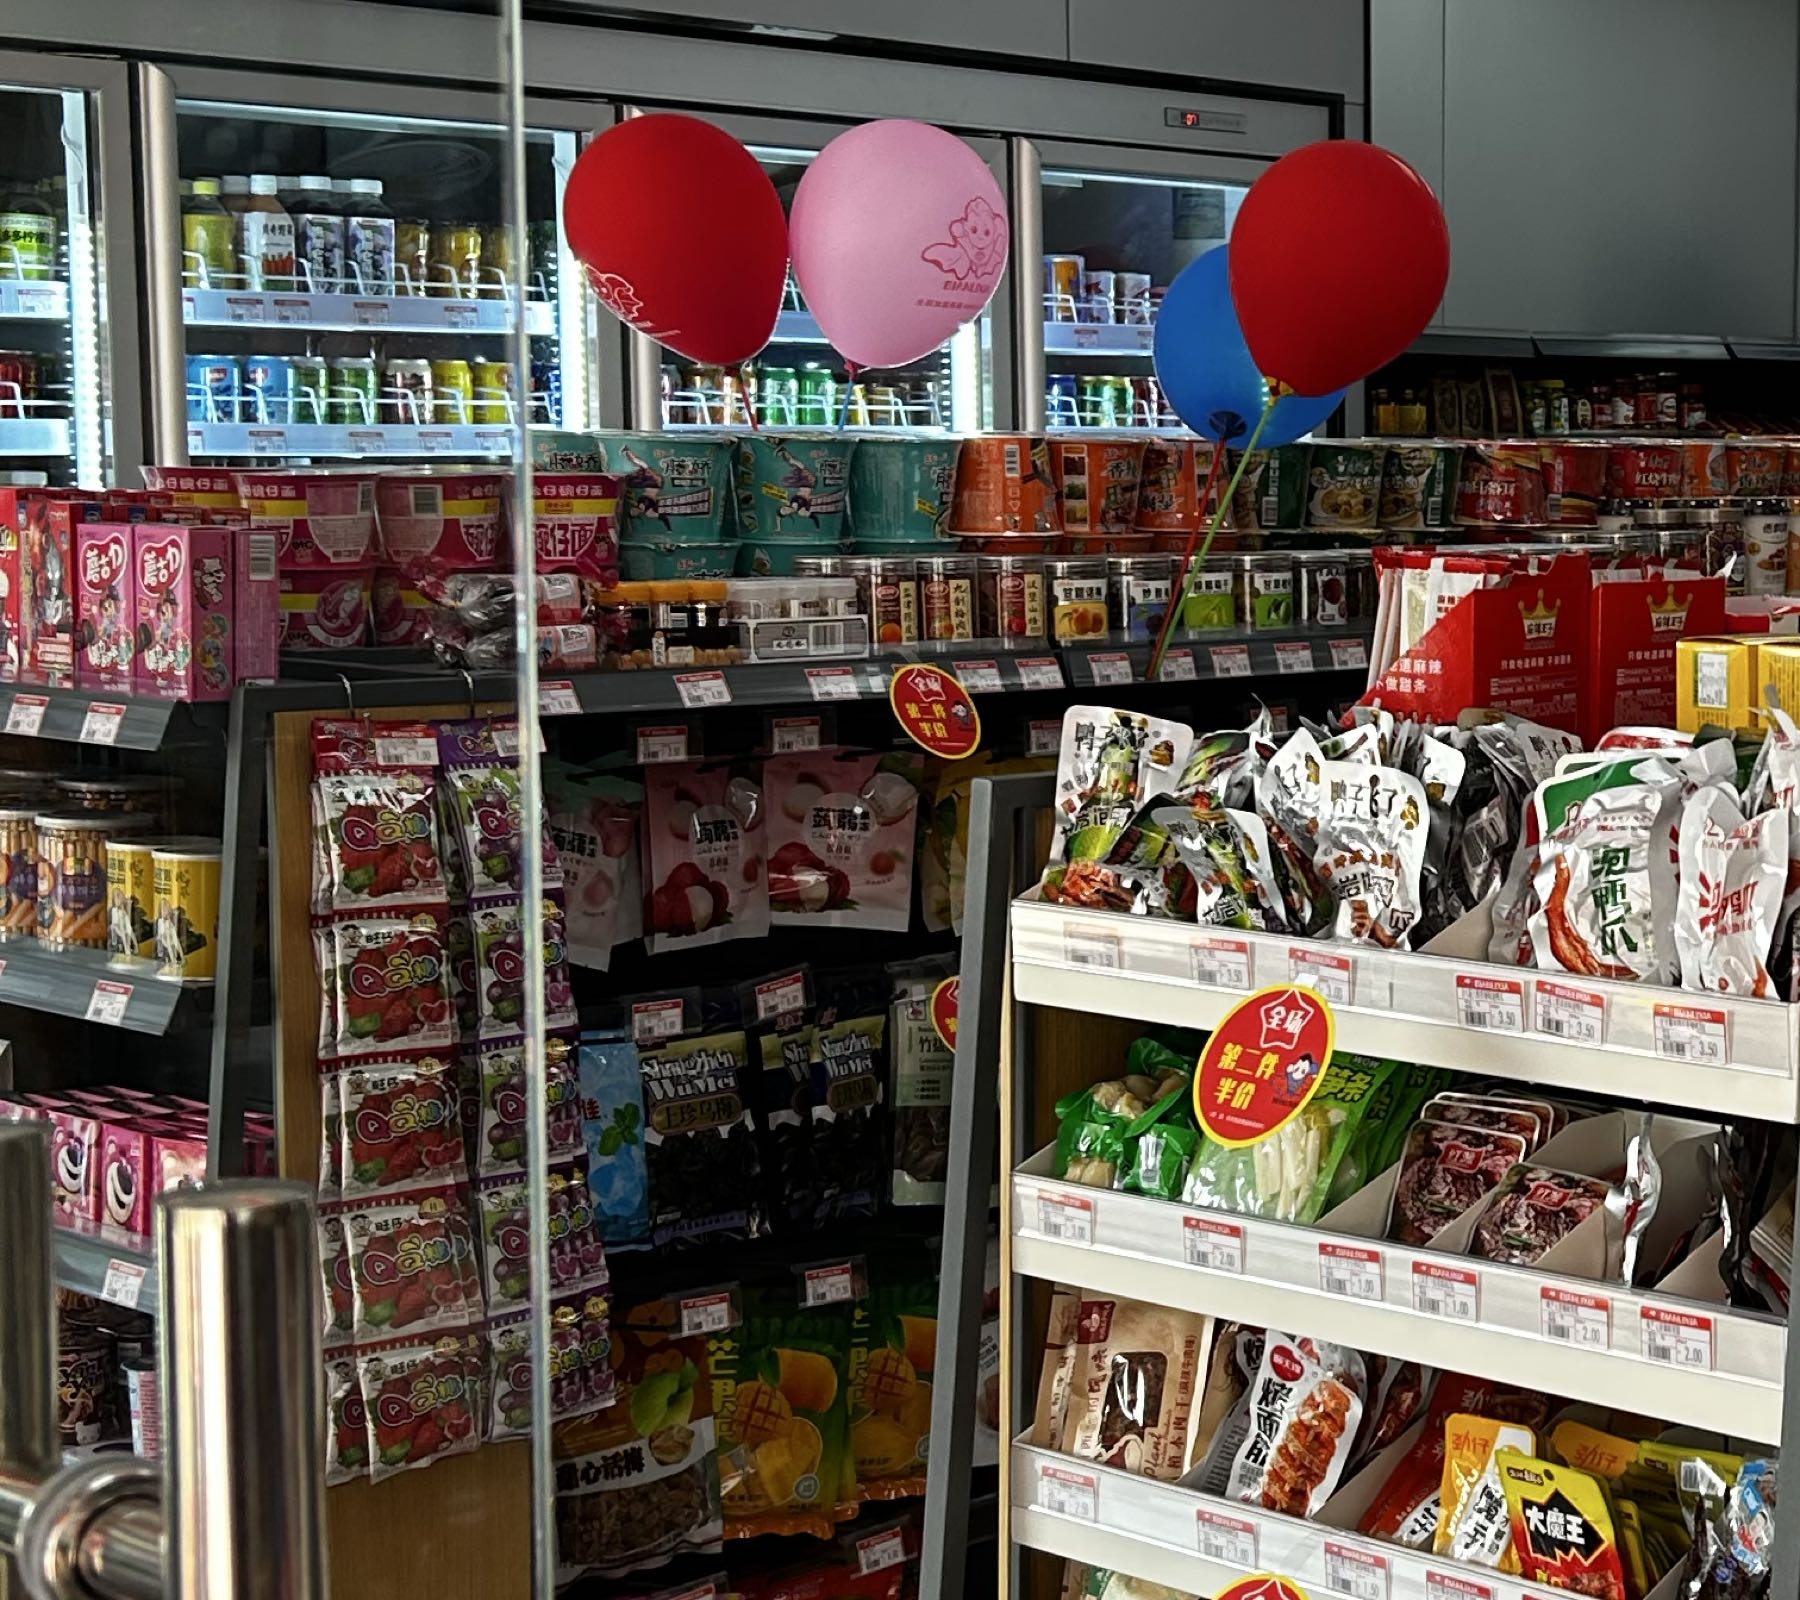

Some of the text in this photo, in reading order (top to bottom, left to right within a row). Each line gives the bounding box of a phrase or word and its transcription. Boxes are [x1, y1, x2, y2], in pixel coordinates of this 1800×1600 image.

[1265, 1008, 1305, 1036] 全场
[1218, 1045, 1277, 1084] 第二件
[1214, 1078, 1254, 1108] 半价
[1523, 1506, 1587, 1549] 大魔王
